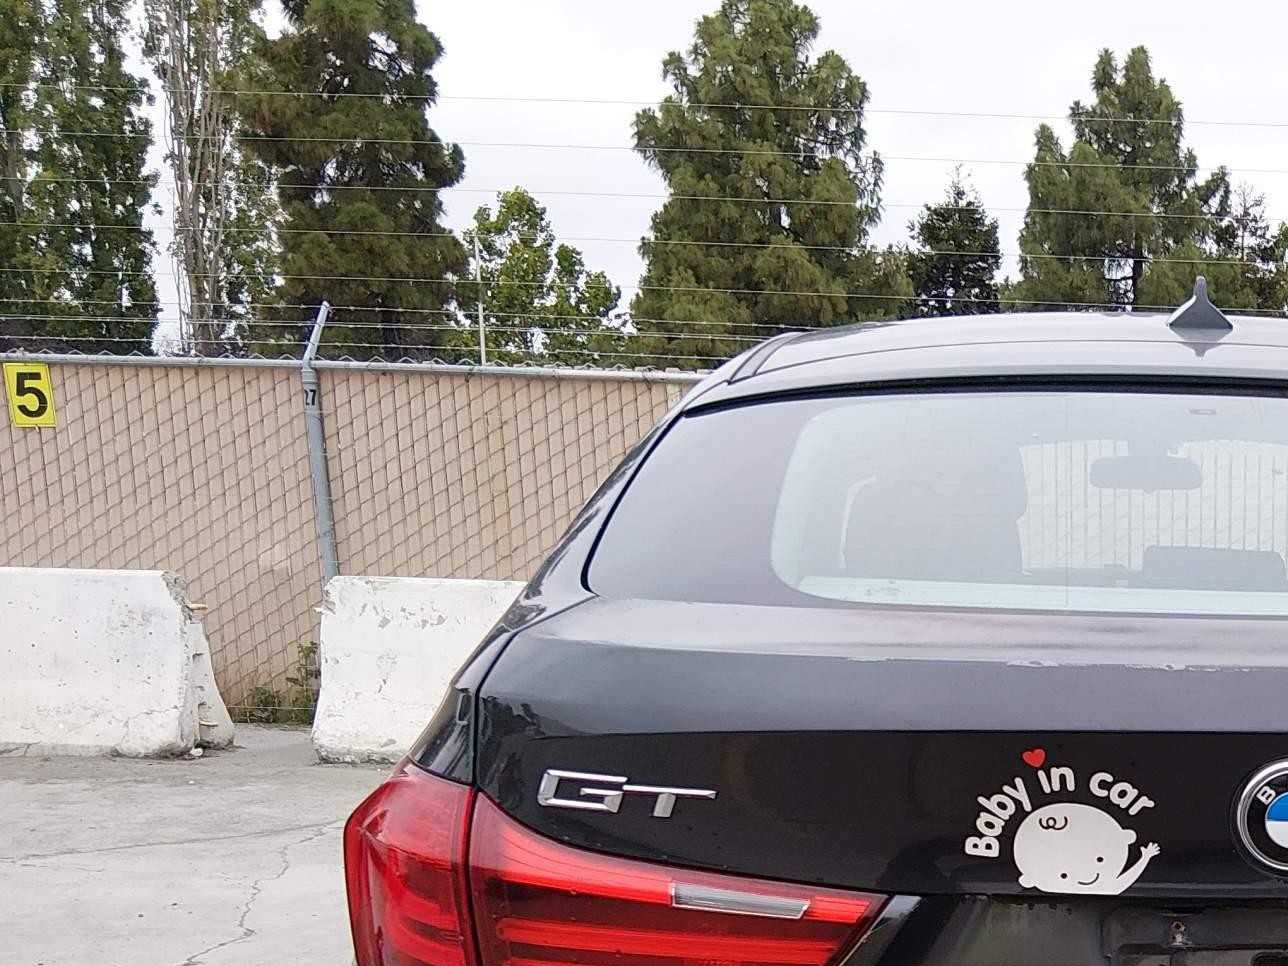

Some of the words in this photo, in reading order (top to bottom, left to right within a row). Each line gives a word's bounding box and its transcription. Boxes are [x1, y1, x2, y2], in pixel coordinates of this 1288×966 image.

[16, 371, 48, 418] 5
[537, 768, 718, 818] GT
[964, 777, 1032, 858] Baby
[1037, 765, 1076, 794] in
[1088, 771, 1155, 816] car
